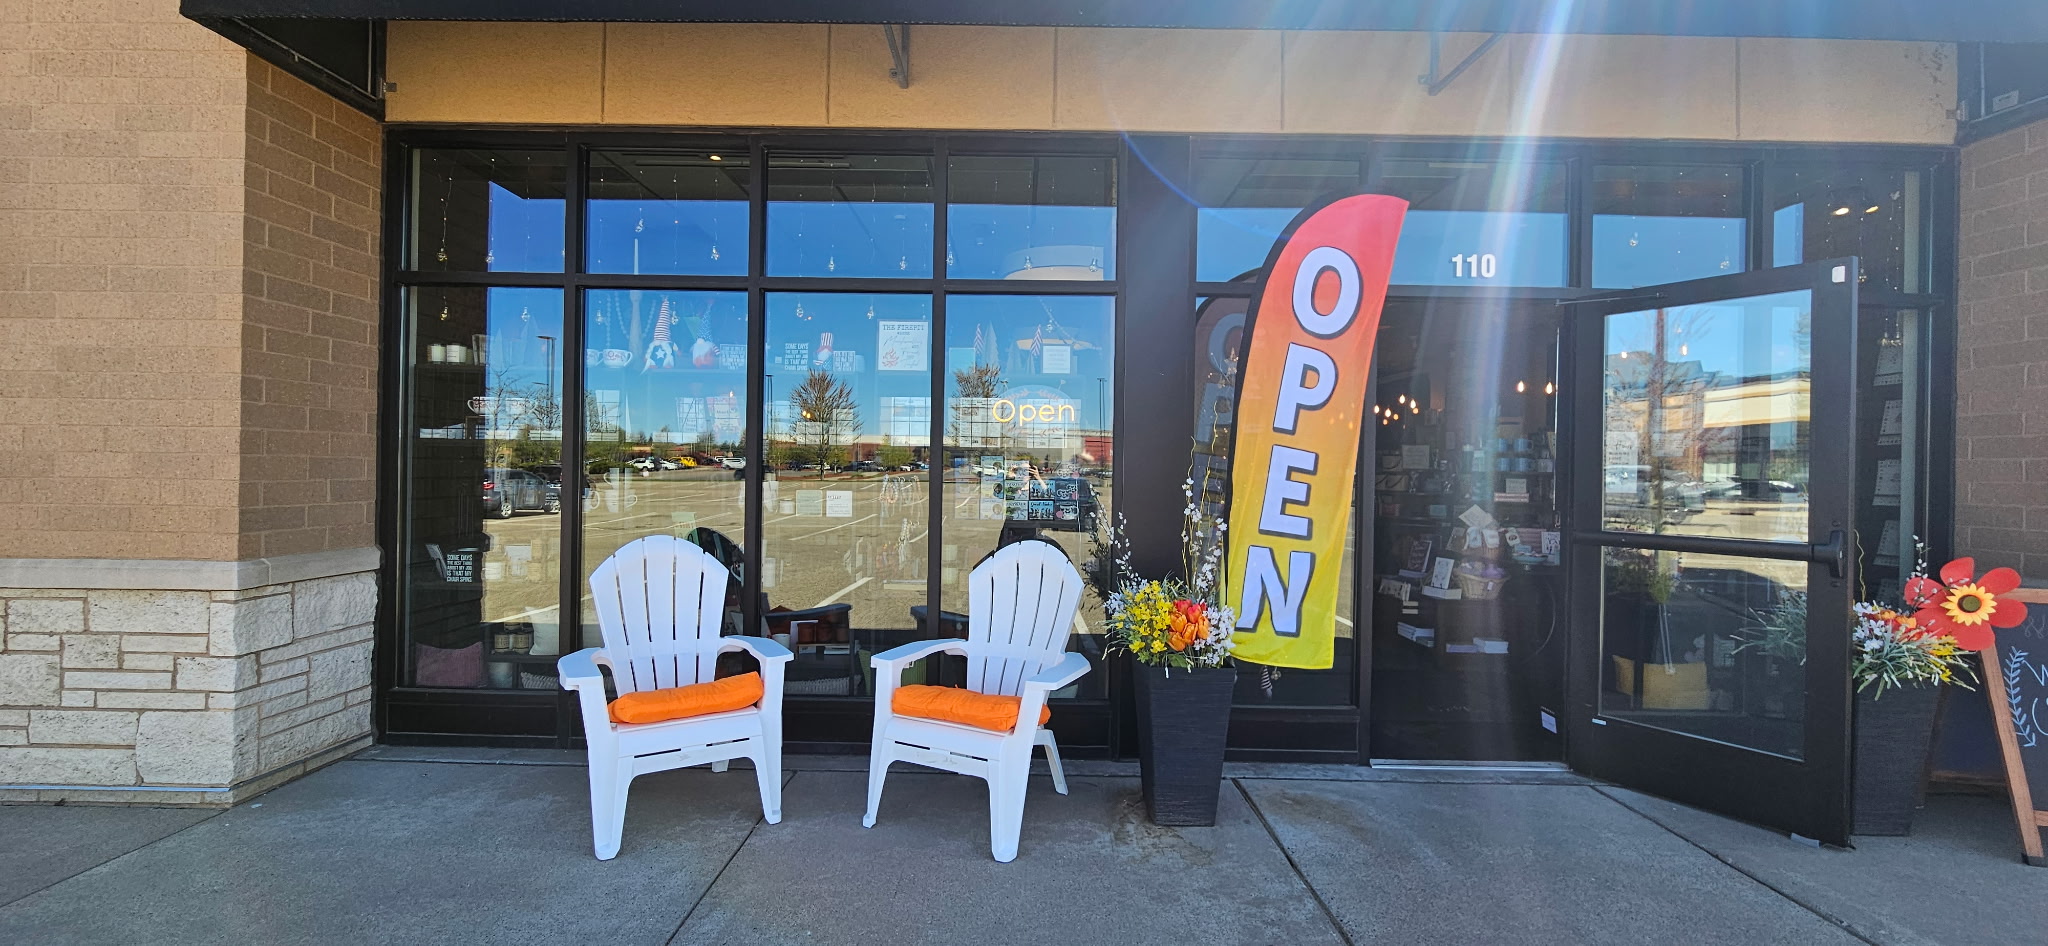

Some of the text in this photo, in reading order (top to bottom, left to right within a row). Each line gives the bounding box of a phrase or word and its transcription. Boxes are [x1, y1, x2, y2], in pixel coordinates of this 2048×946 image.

[1452, 253, 1496, 278] 110
[992, 399, 1075, 427] Open
[1235, 246, 1363, 637] OPEN
